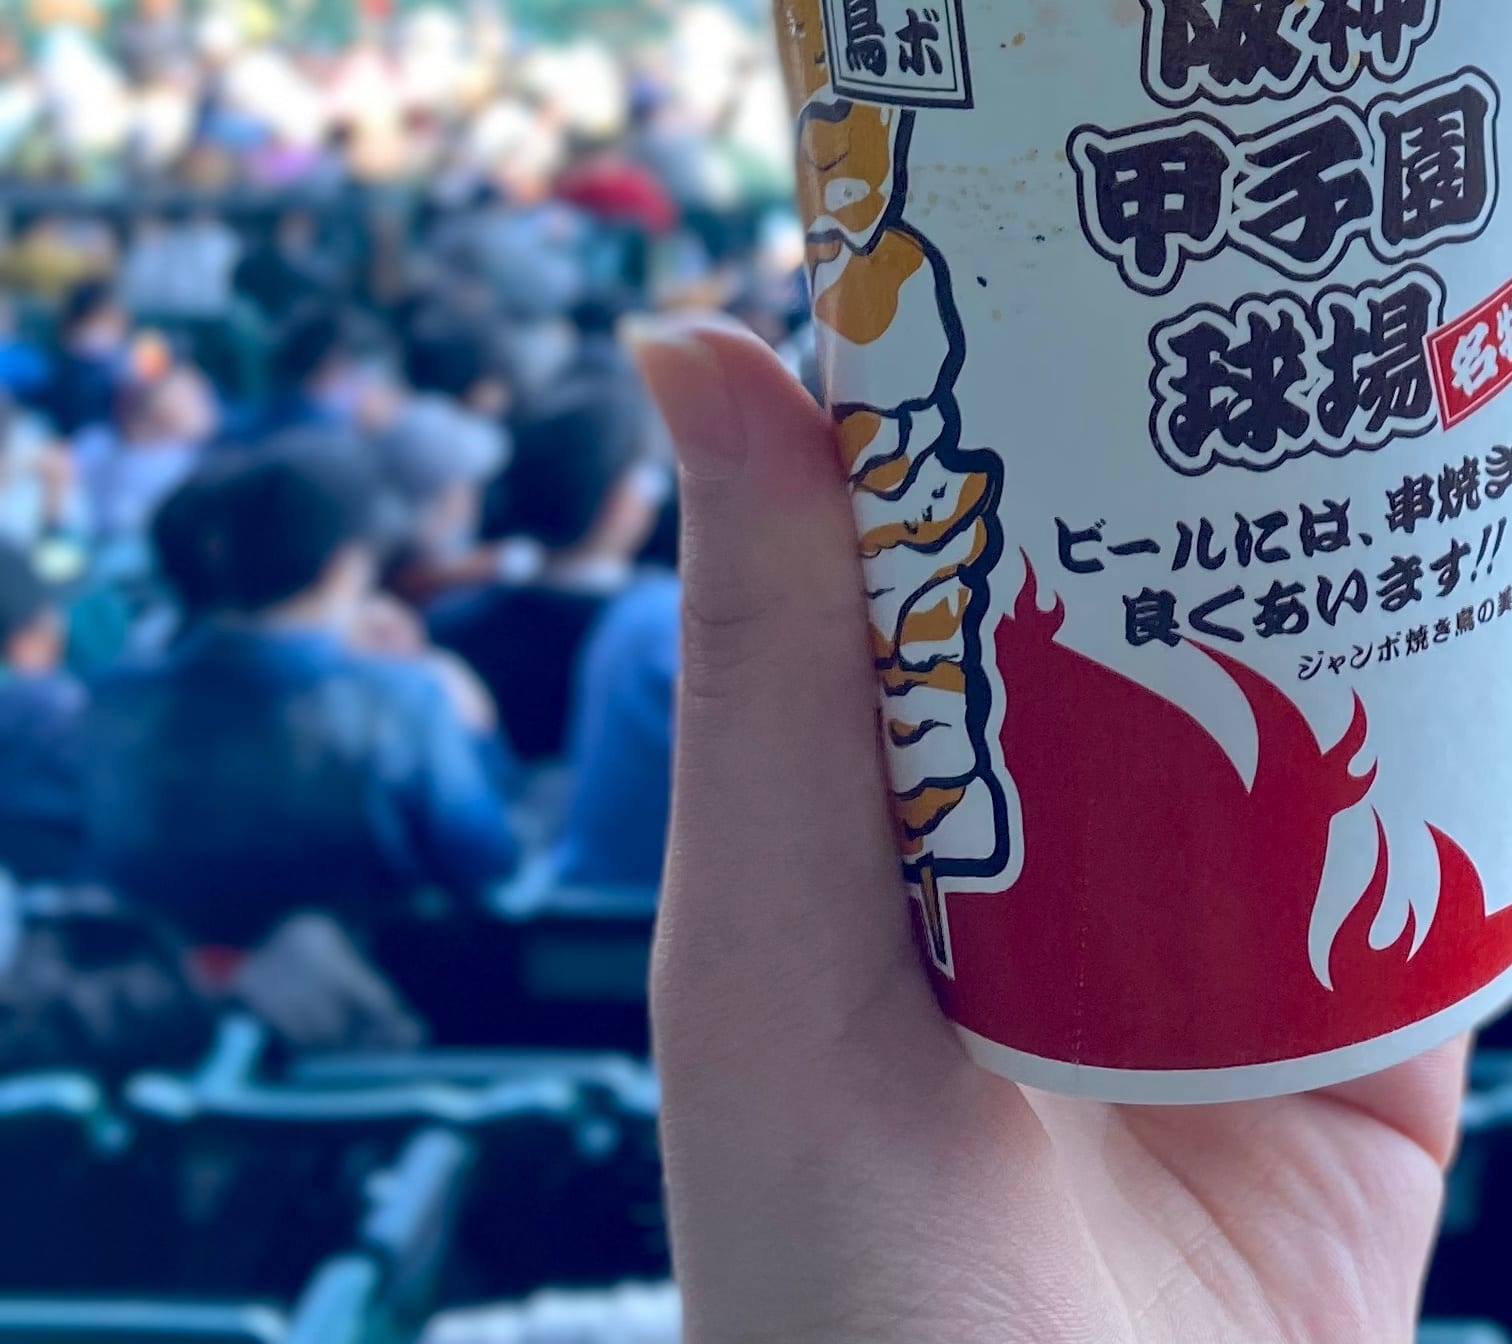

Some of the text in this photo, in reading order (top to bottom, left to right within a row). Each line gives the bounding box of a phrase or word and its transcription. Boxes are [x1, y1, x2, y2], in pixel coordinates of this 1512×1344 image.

[1074, 72, 1498, 289] 甲子園
[1153, 268, 1444, 470] 球場
